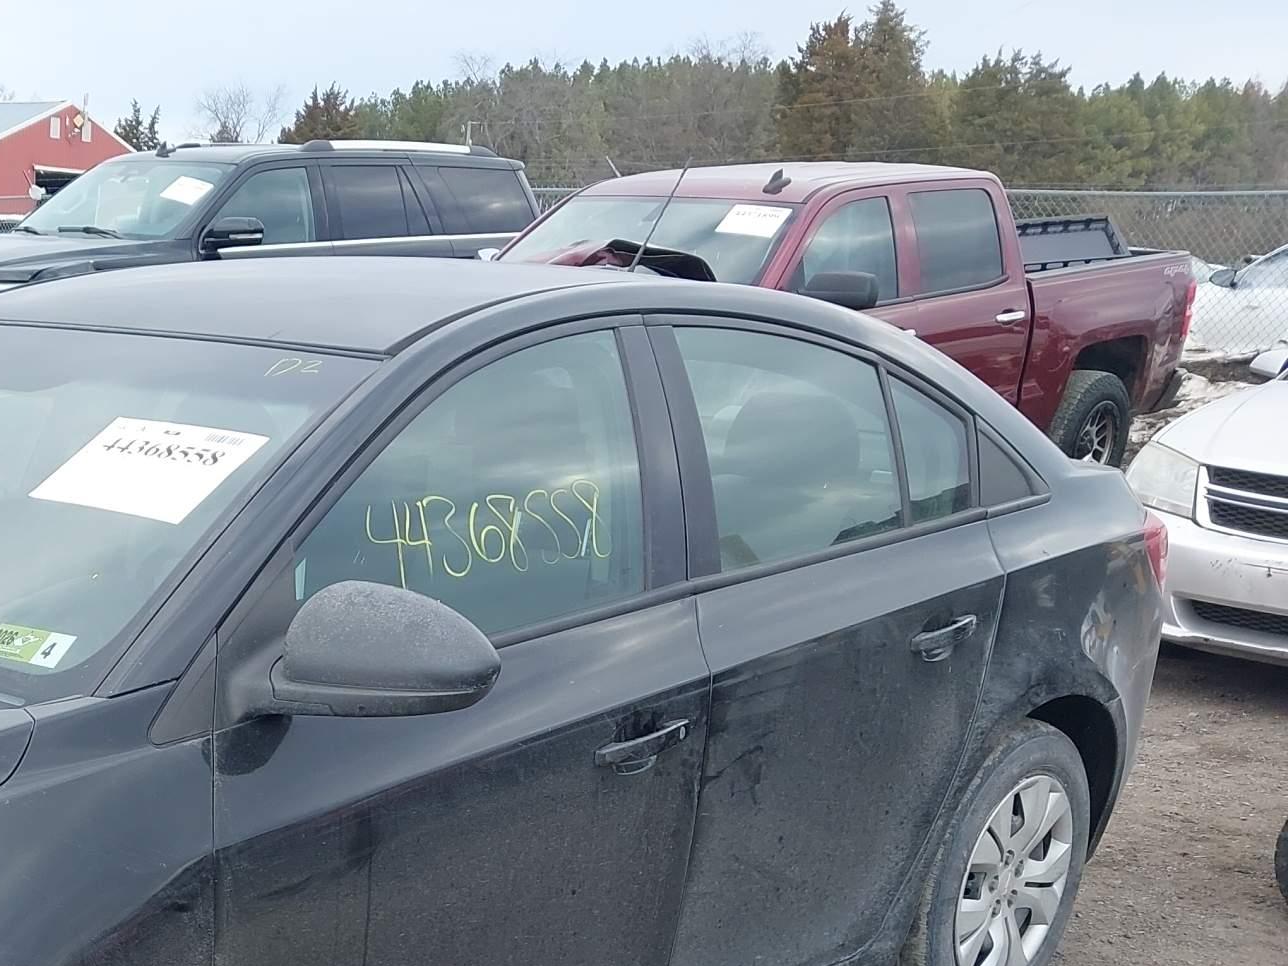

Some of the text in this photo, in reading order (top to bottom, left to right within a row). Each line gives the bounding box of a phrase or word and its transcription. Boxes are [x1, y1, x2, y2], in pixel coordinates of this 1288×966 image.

[103, 437, 226, 467] 44368558
[365, 479, 612, 590] 44368558
[40, 641, 58, 660] 4
